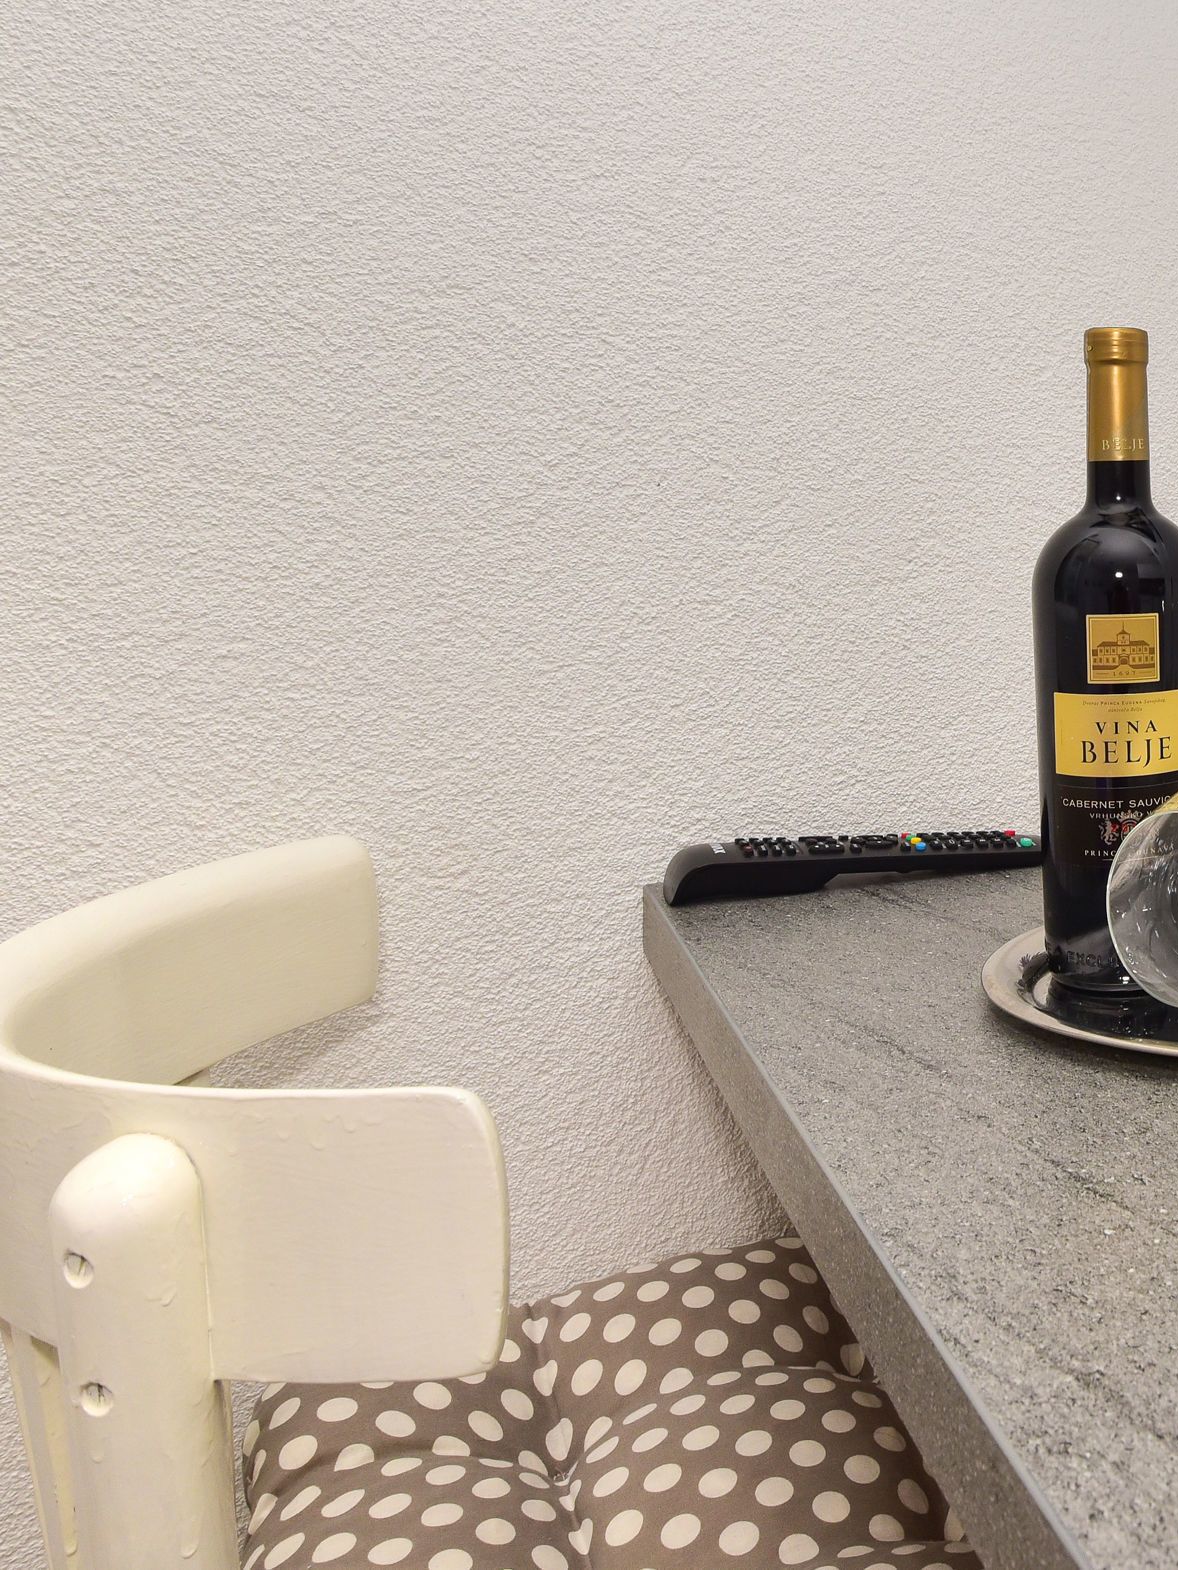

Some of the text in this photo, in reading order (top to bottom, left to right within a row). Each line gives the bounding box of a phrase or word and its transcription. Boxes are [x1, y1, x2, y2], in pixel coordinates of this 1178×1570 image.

[1095, 719, 1158, 735] VINA
[1081, 736, 1173, 769] BELJE
[1062, 797, 1124, 809] CABERNET
